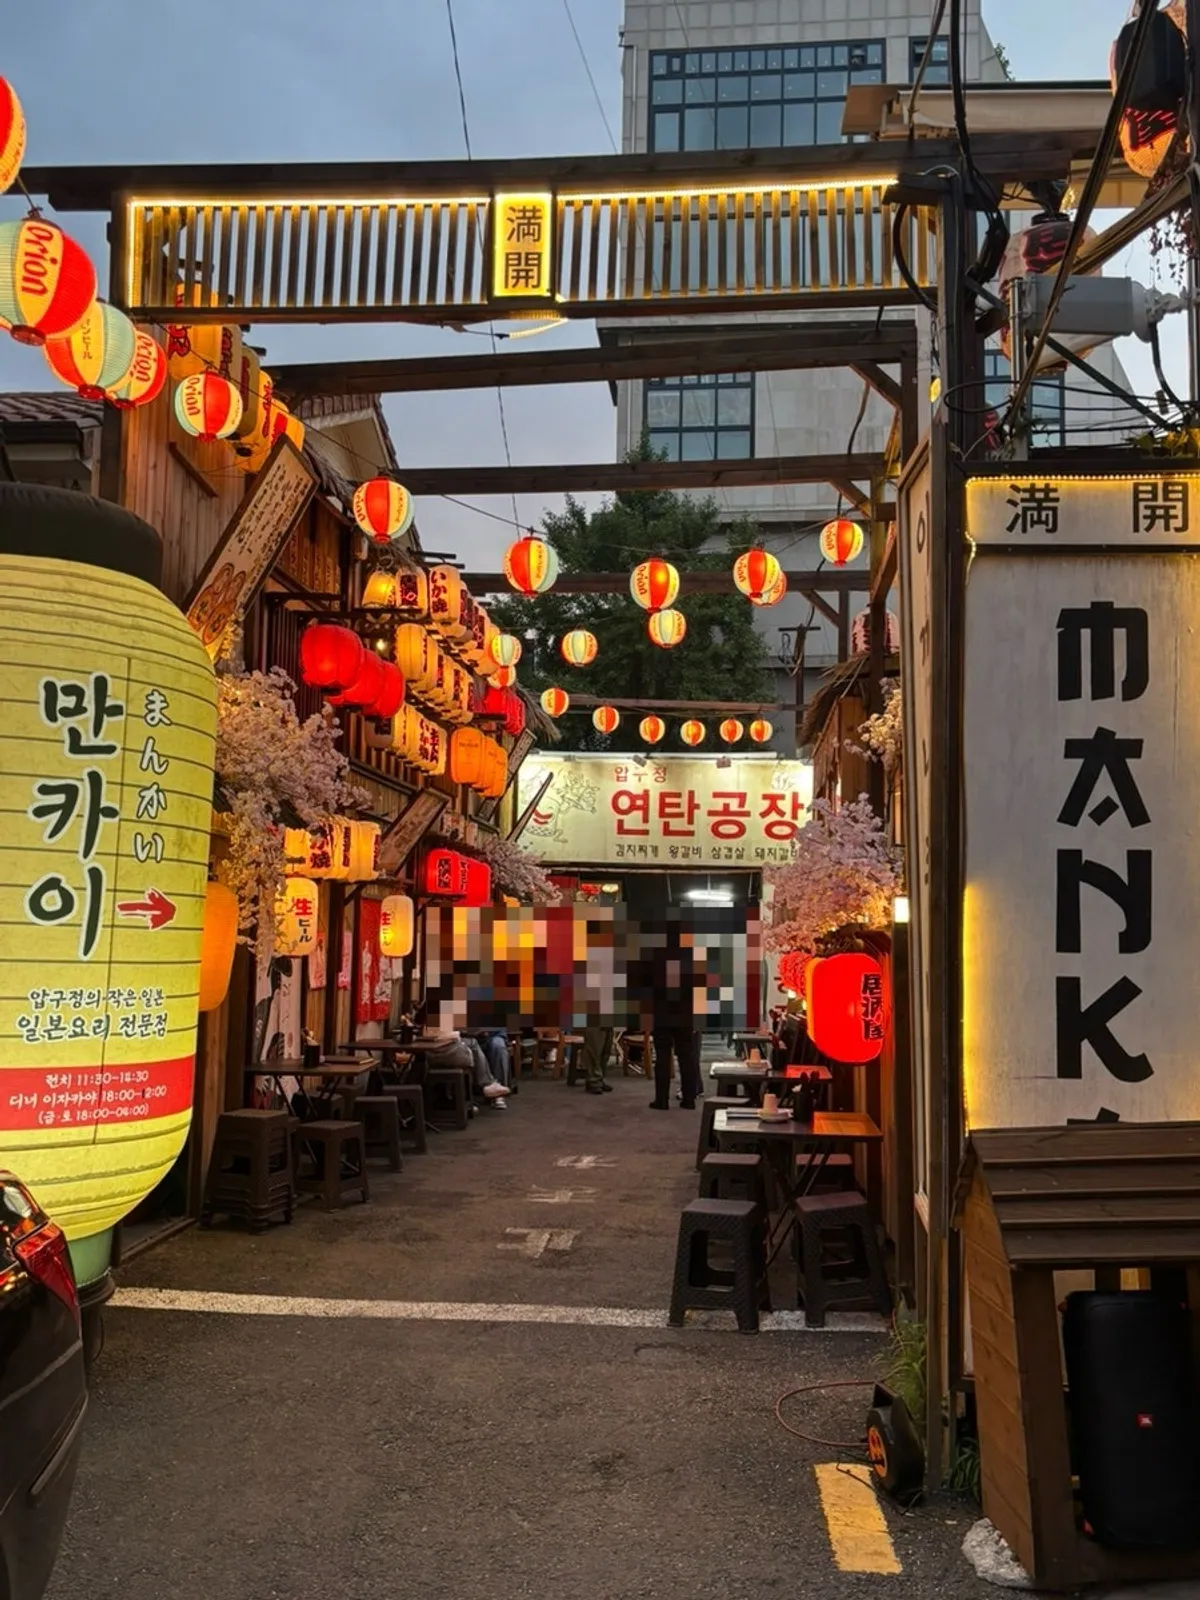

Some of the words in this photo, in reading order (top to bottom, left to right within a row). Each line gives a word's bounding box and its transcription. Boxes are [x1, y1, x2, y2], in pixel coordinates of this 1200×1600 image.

[506, 205, 543, 289] 満開
[134, 688, 173, 863] まんかい
[29, 674, 125, 958] 만카이
[611, 788, 805, 841] 연탄공장
[30, 988, 101, 1009] 압구정의
[108, 989, 137, 1009] 작은
[141, 988, 164, 1008] 일본
[18, 1014, 110, 1041] 일본요리
[120, 1013, 168, 1037] 전문점
[45, 1072, 72, 1089] 런치
[9, 1093, 38, 1110] 디너
